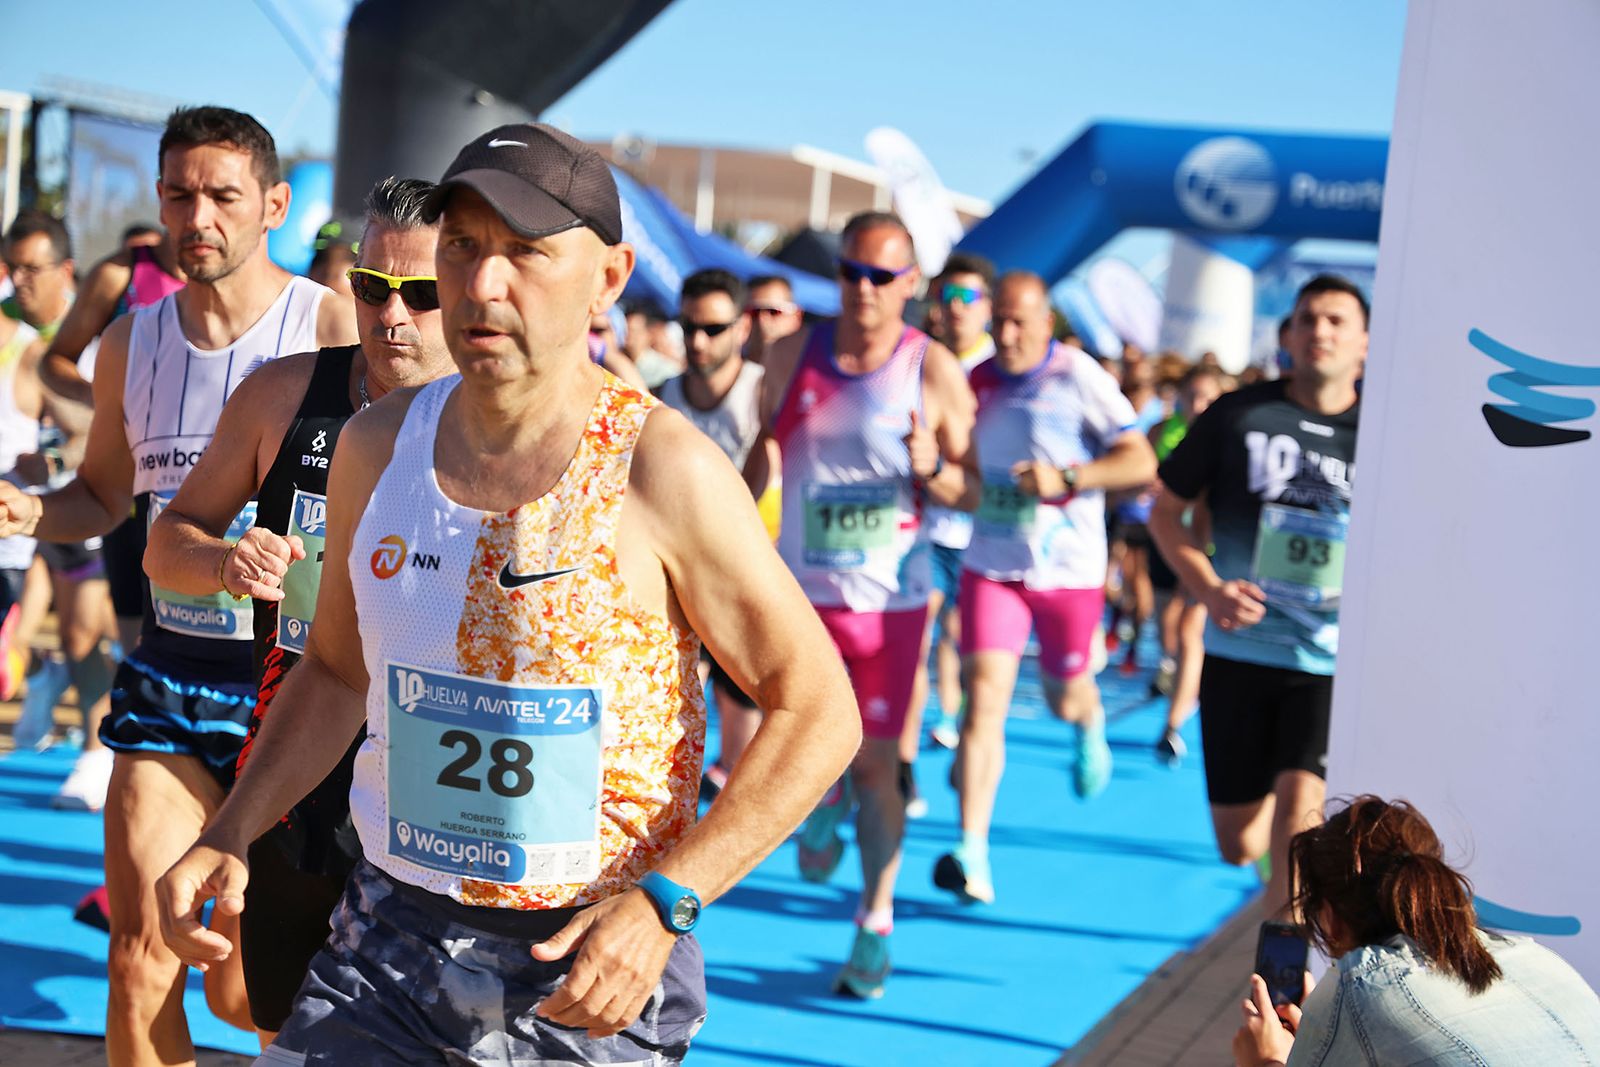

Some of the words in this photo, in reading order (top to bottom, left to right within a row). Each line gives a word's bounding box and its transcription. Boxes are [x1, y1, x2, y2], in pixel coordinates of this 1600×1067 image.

[1290, 172, 1384, 211] Puert
[139, 452, 171, 472] new
[301, 454, 329, 469] BY2
[412, 552, 441, 571] NN
[1287, 534, 1331, 567] 93
[169, 604, 227, 626] Wayalia
[396, 669, 424, 713] 10
[423, 684, 469, 707] HUELVA
[474, 695, 546, 718] AVATEL
[436, 729, 535, 798] 28
[459, 811, 506, 826] ROBERTO
[440, 821, 479, 837] HUERGA
[479, 828, 527, 842] SERRANO
[413, 828, 511, 868] Wayalia
